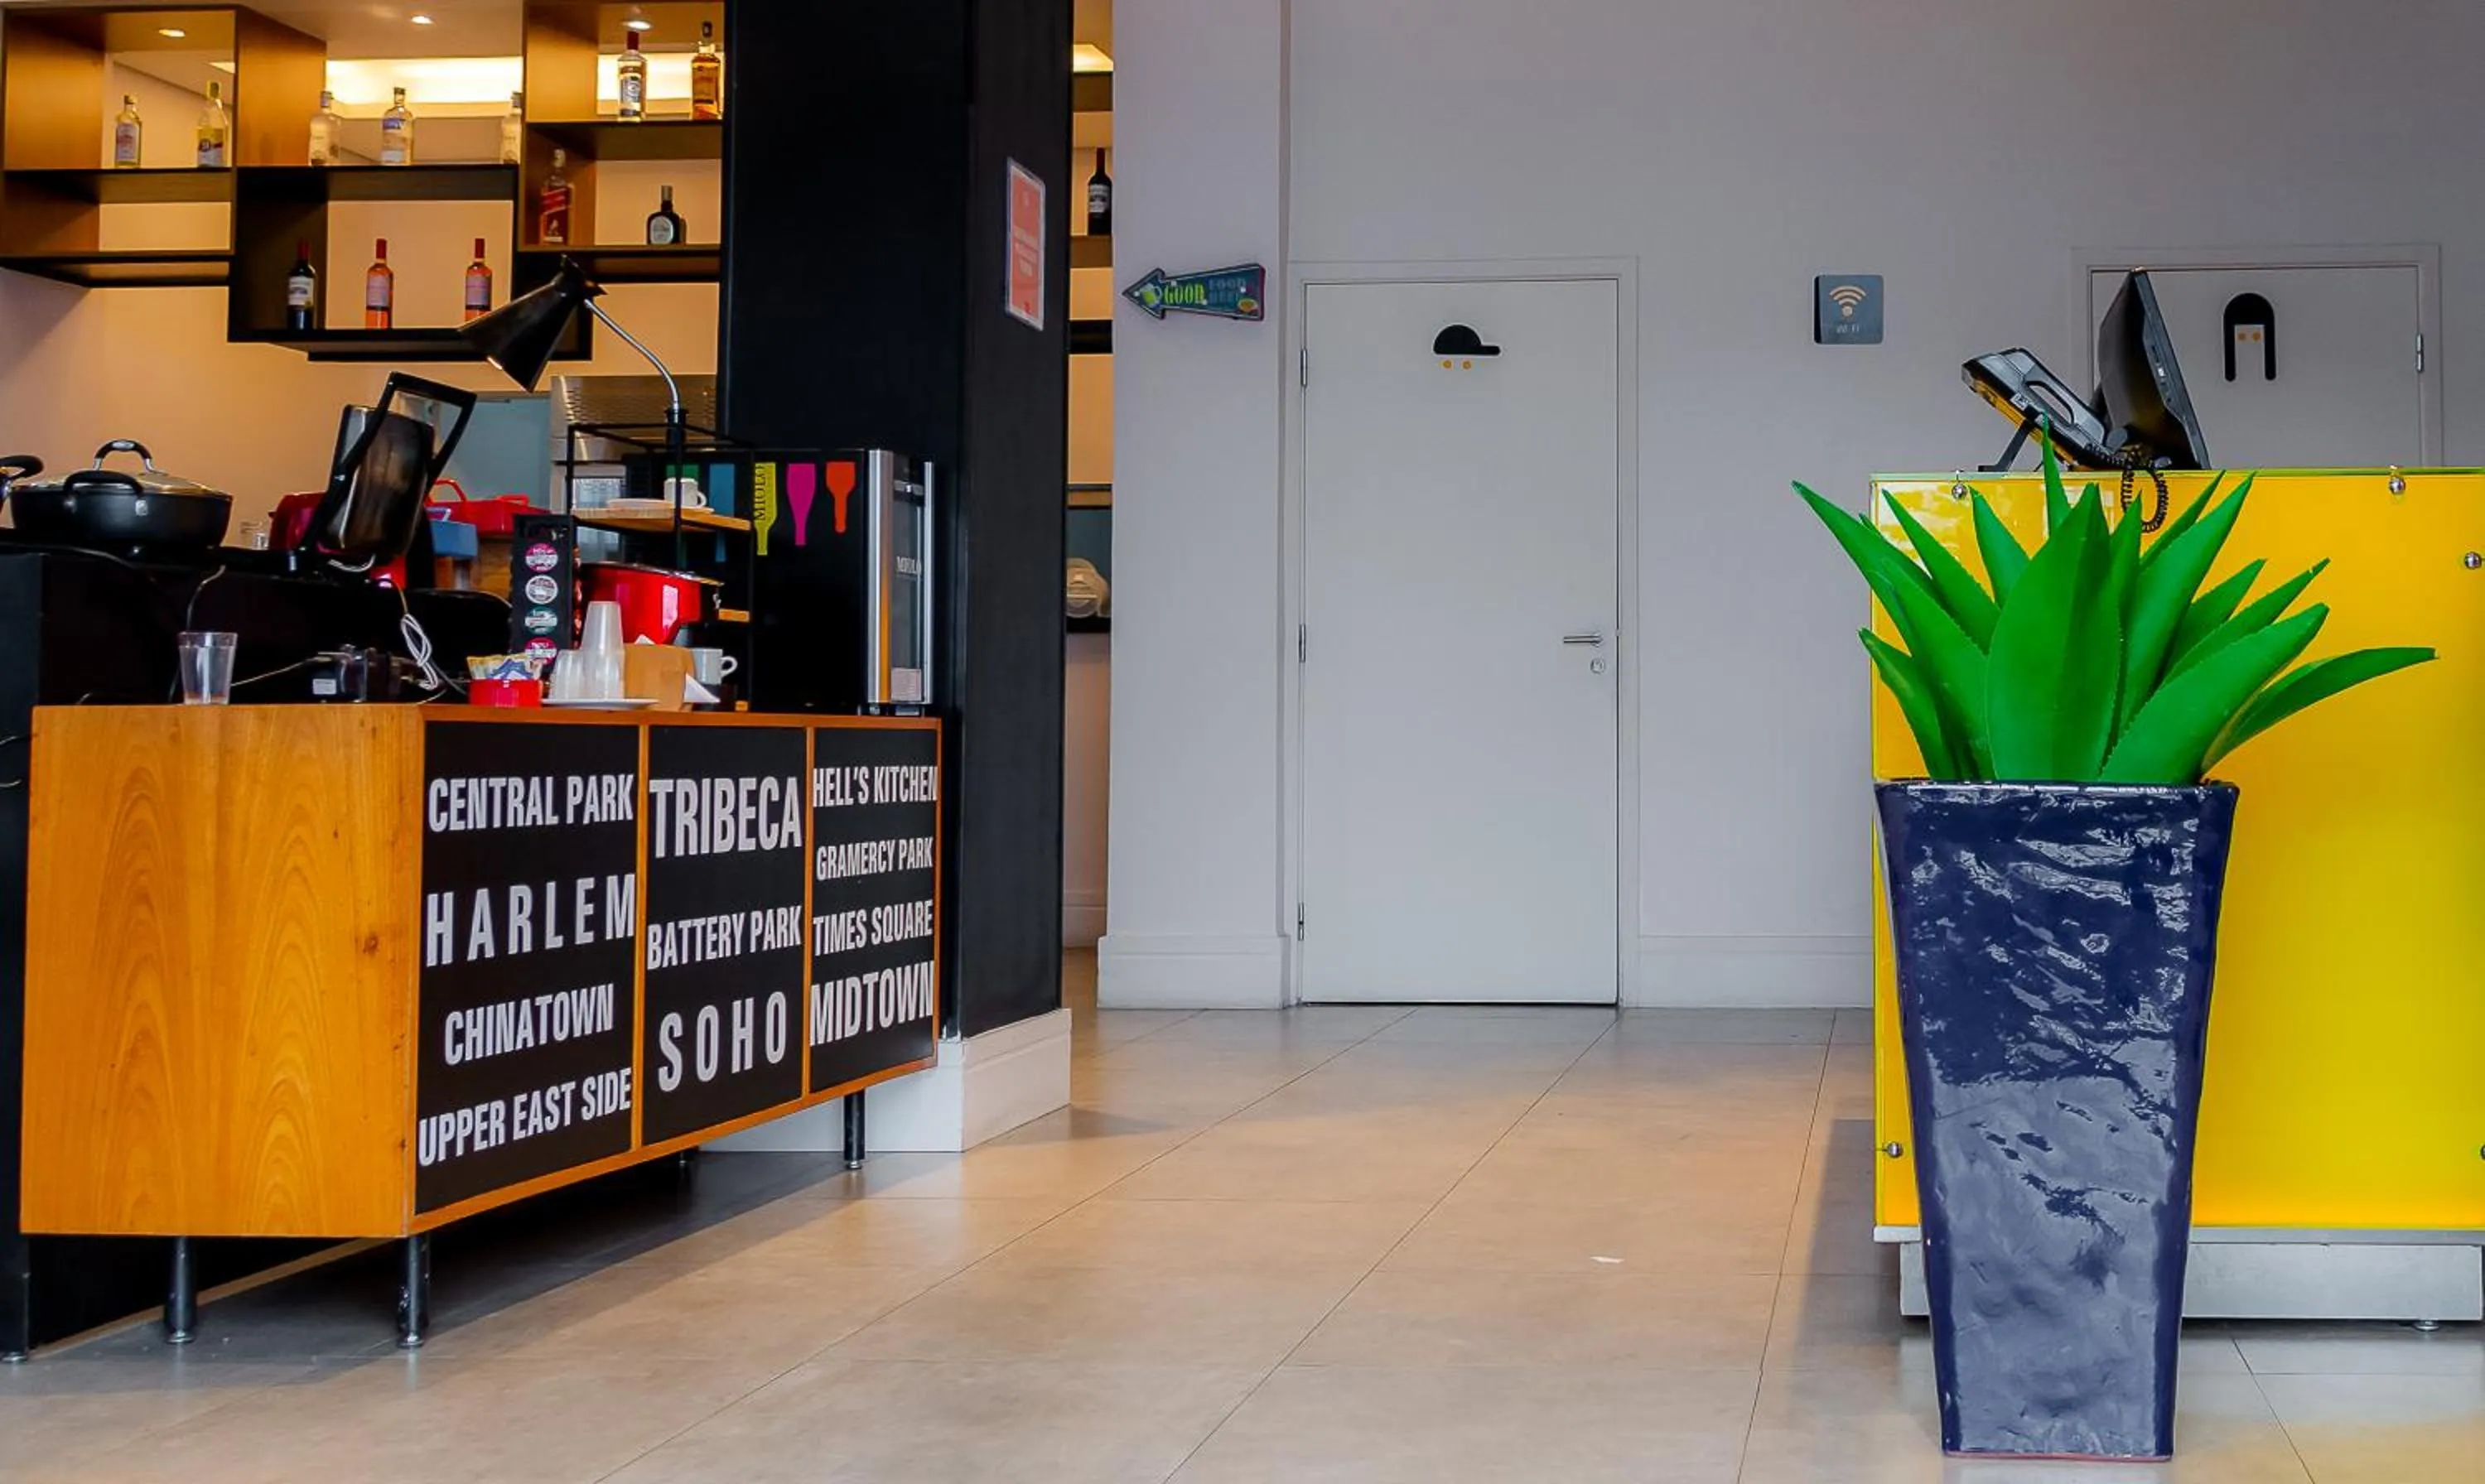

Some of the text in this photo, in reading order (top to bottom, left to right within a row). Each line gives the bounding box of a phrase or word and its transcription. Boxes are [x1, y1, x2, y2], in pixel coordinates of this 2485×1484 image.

[1164, 283, 1206, 304] GOOD
[429, 774, 634, 831] CENTRAL PARK
[649, 777, 802, 858] TRIBECA
[813, 766, 938, 807] HELL'S KITCHEN
[817, 837, 933, 880] GRAMERCY PARK
[427, 874, 635, 966] HARLEM
[648, 905, 801, 970] BATTERY PARK
[813, 899, 933, 956] TIMES SQUARE
[445, 984, 613, 1065] CHINATOWN
[810, 961, 934, 1047] MIDTOWN
[659, 991, 786, 1091] SOHO
[419, 1067, 631, 1166] UPPER EAST SIDE
